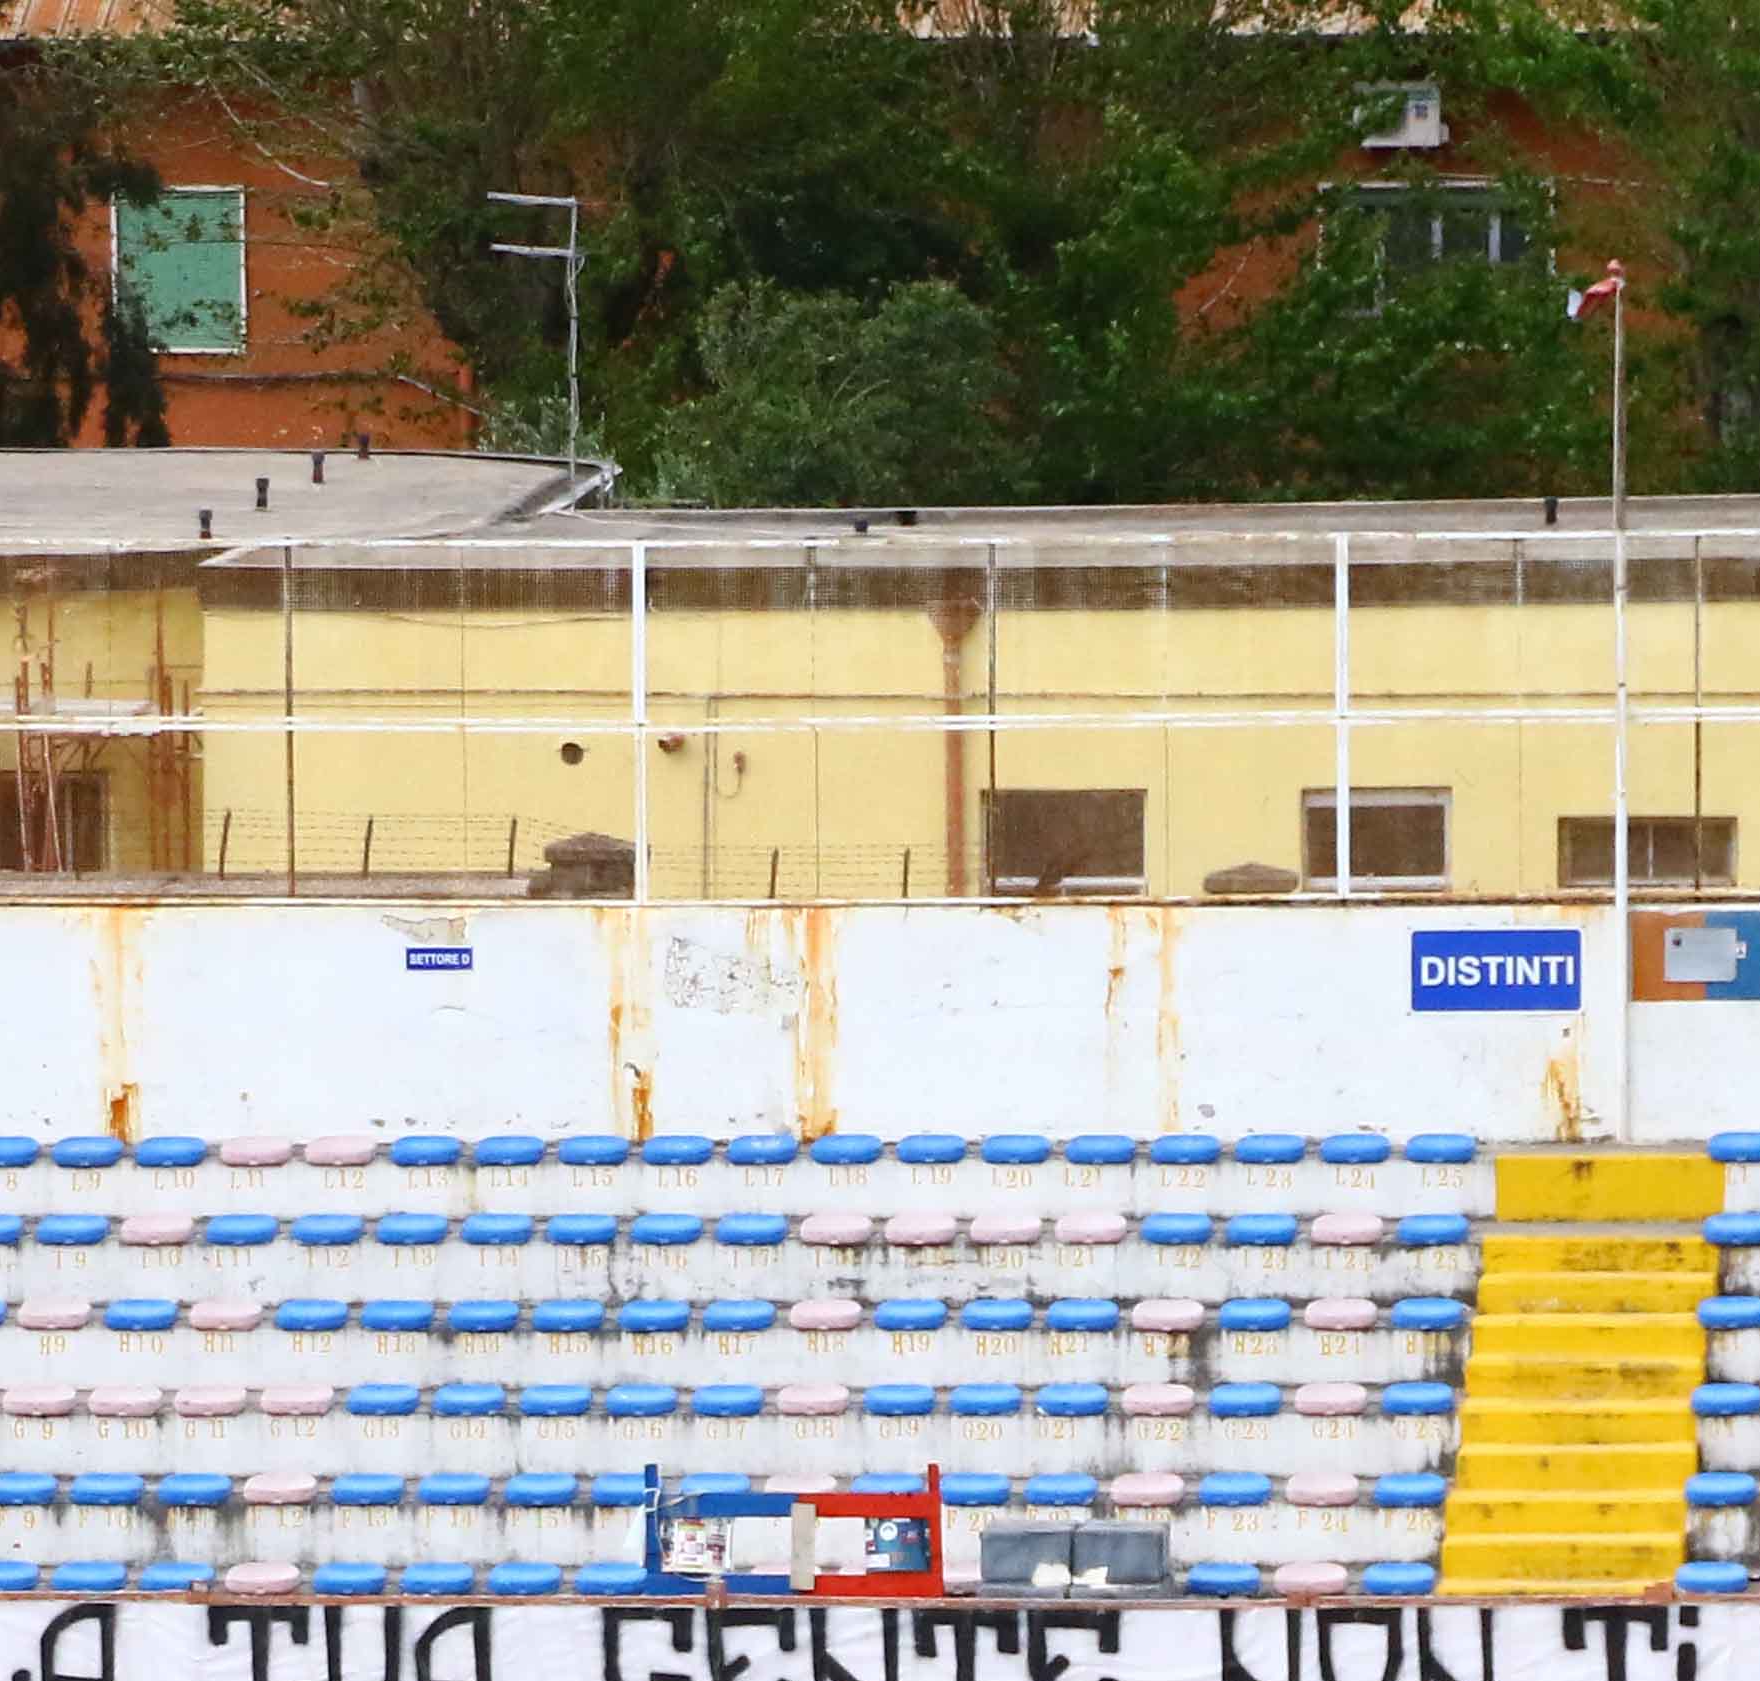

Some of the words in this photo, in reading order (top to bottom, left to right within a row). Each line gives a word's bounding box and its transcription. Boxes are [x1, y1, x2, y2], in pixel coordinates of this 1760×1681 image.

[409, 953, 460, 966] SETTORE
[461, 953, 471, 966] D
[1420, 955, 1575, 987] DISTINTI
